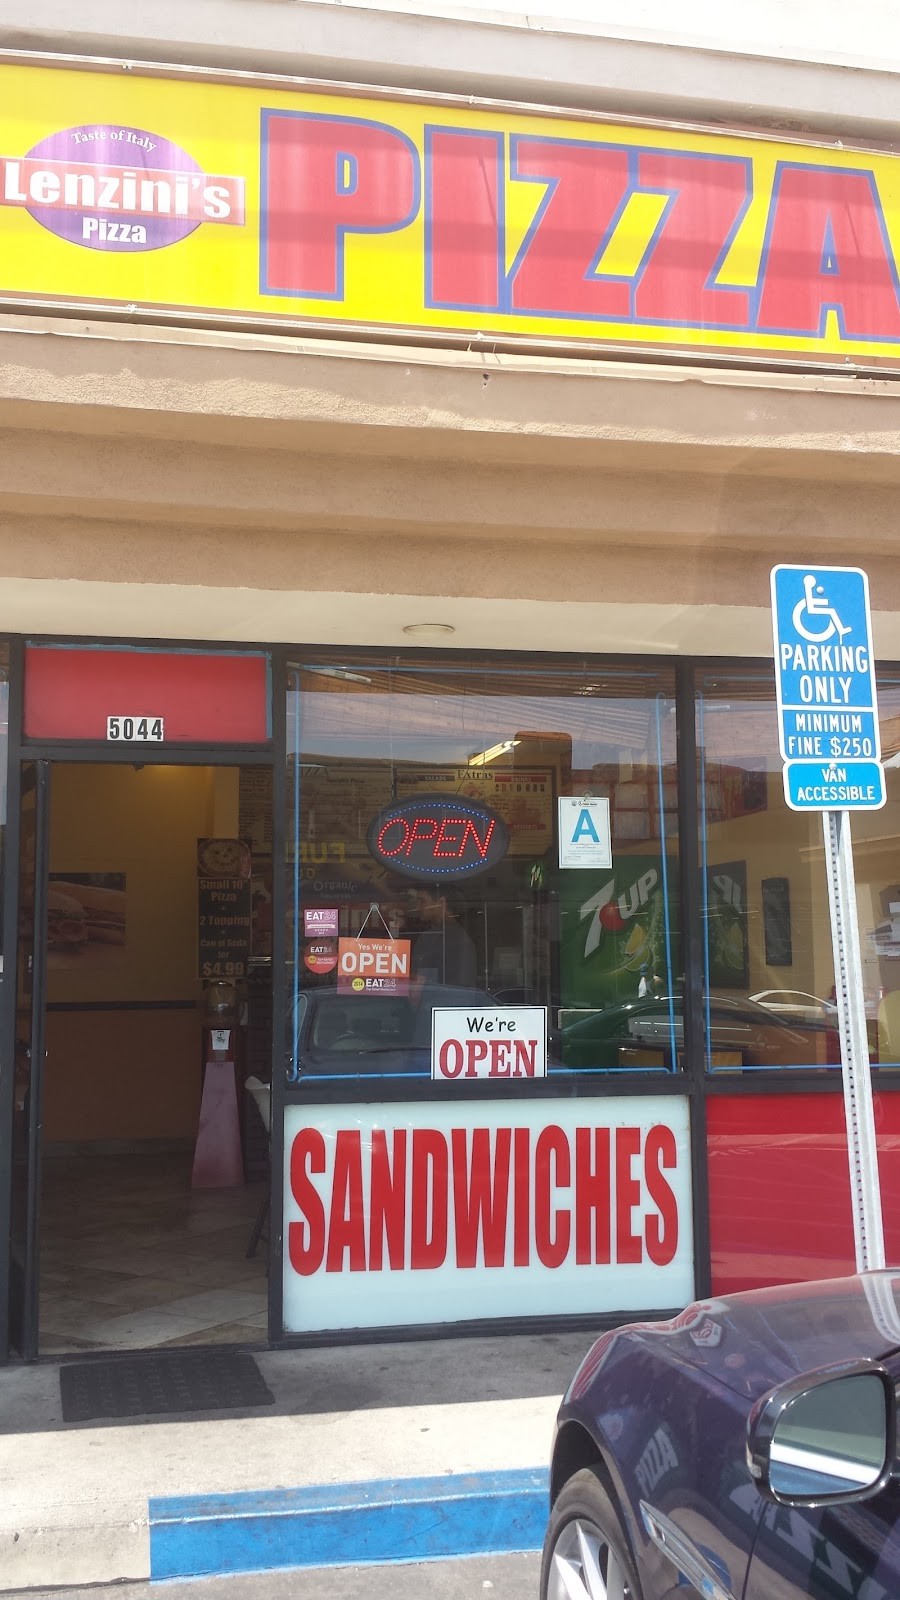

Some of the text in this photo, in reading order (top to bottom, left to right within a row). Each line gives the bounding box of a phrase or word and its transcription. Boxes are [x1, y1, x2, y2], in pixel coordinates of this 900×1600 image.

[70, 130, 157, 154] Taste of Italy
[4, 161, 232, 219] Lenzini's
[82, 217, 147, 244] Pizza
[259, 107, 900, 342] PIZZA
[780, 643, 869, 674] PARKING
[799, 675, 852, 704] ONLY
[109, 717, 162, 740] 5044
[795, 713, 862, 733] MINIMUM
[788, 736, 872, 757] FINE $250
[821, 768, 847, 782] VAN
[797, 786, 876, 801] ACCESSIBLE
[377, 817, 496, 858] OPEN
[571, 808, 600, 843] A
[358, 943, 392, 952] Yes We're
[202, 961, 244, 977] $4.99
[341, 951, 407, 974] OPEN
[467, 1016, 517, 1033] We're
[439, 1038, 538, 1079] OPEN
[288, 1125, 679, 1276] SANDWICHES
